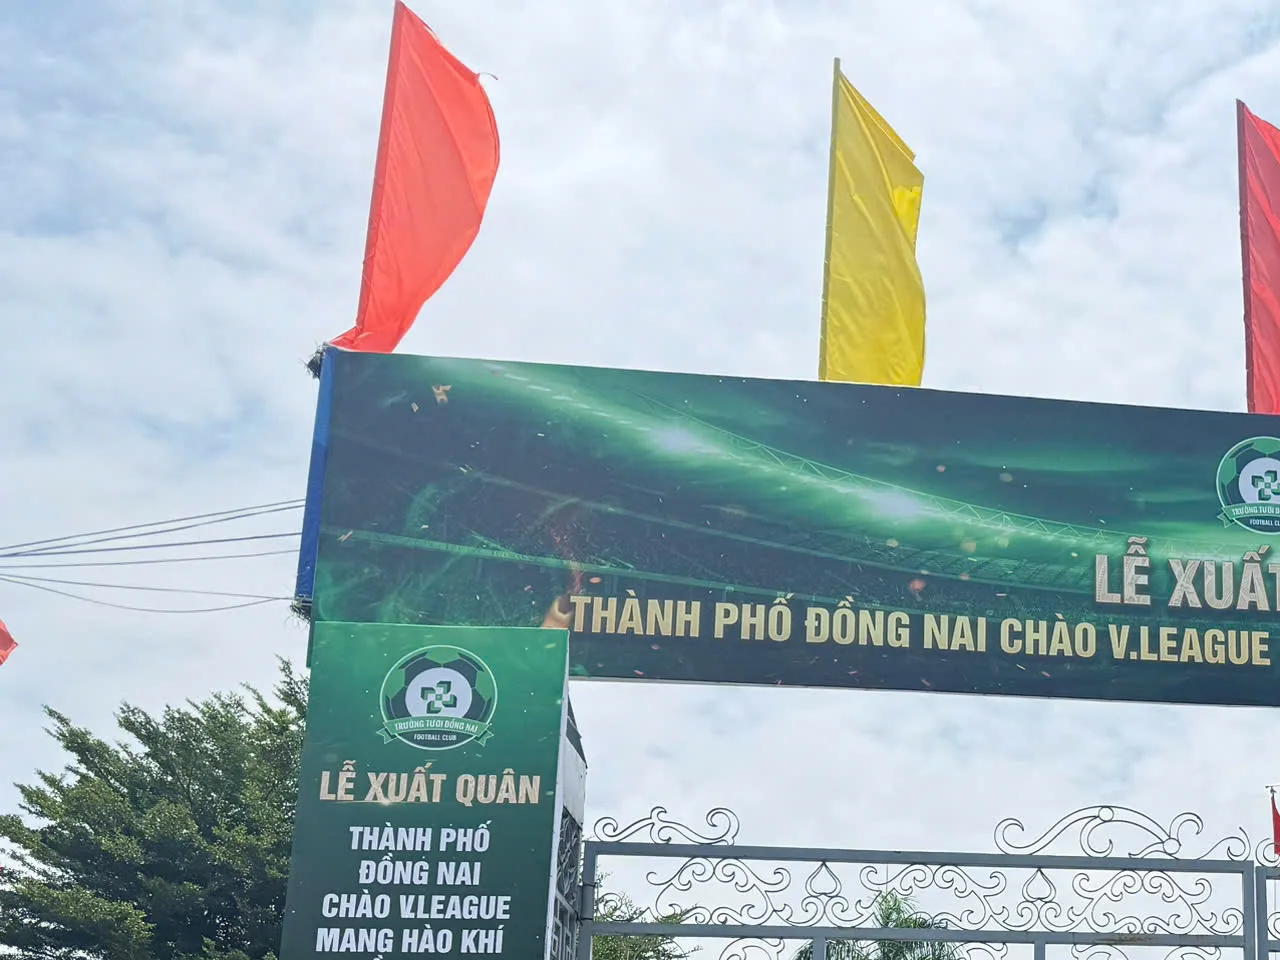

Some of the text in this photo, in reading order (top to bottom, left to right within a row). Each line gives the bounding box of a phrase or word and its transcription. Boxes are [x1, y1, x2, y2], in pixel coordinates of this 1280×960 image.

[1095, 537, 1151, 604] LỄ
[570, 589, 700, 637] THÀNH
[714, 592, 795, 641] PHỐ
[805, 596, 910, 648] ĐỒNG
[923, 614, 987, 652] NAI
[1001, 613, 1097, 657] CHÀO
[1108, 624, 1271, 665] V.LEAGUE
[320, 760, 541, 807] LỄ XUẤT QUÂN
[350, 819, 492, 852] THÀNH PHỐ
[358, 853, 480, 885] ĐỒNG NAI
[322, 889, 390, 919] CHÀO
[316, 924, 505, 953] MANG HÀO KHÍ
